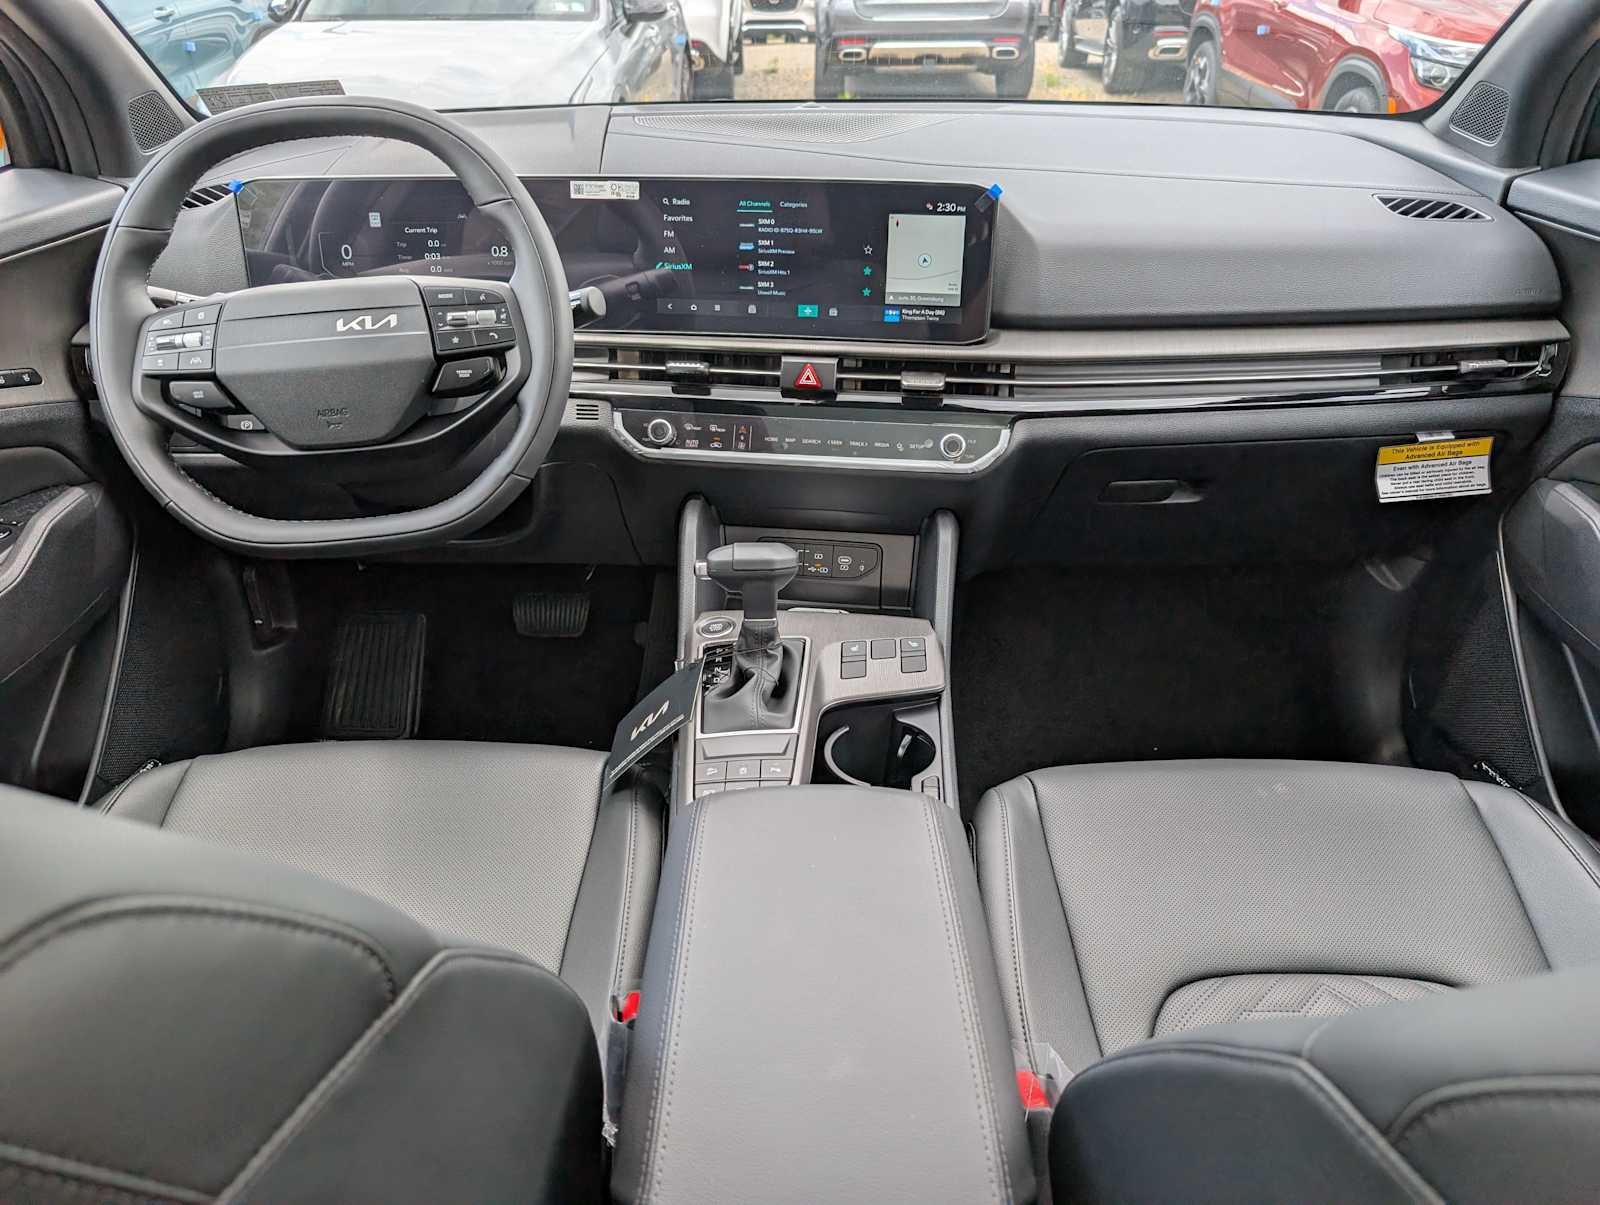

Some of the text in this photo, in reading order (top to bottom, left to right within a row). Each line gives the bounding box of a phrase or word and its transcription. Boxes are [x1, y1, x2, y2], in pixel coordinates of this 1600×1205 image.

[672, 198, 690, 206] Radio
[780, 201, 808, 209] Categories
[936, 203, 957, 212] 2:30
[664, 214, 694, 222] Favorites
[404, 226, 438, 234] Current Trip
[664, 230, 675, 238] FM
[341, 244, 353, 260] 0
[491, 246, 508, 257] 0.8
[664, 246, 676, 254] AM
[424, 252, 441, 260] 0:03
[430, 265, 442, 273] 0.0
[663, 262, 693, 271] SiriusXM
[336, 314, 398, 332] KIA
[1436, 442, 1466, 450] Equipped
[630, 699, 670, 741] KIA
